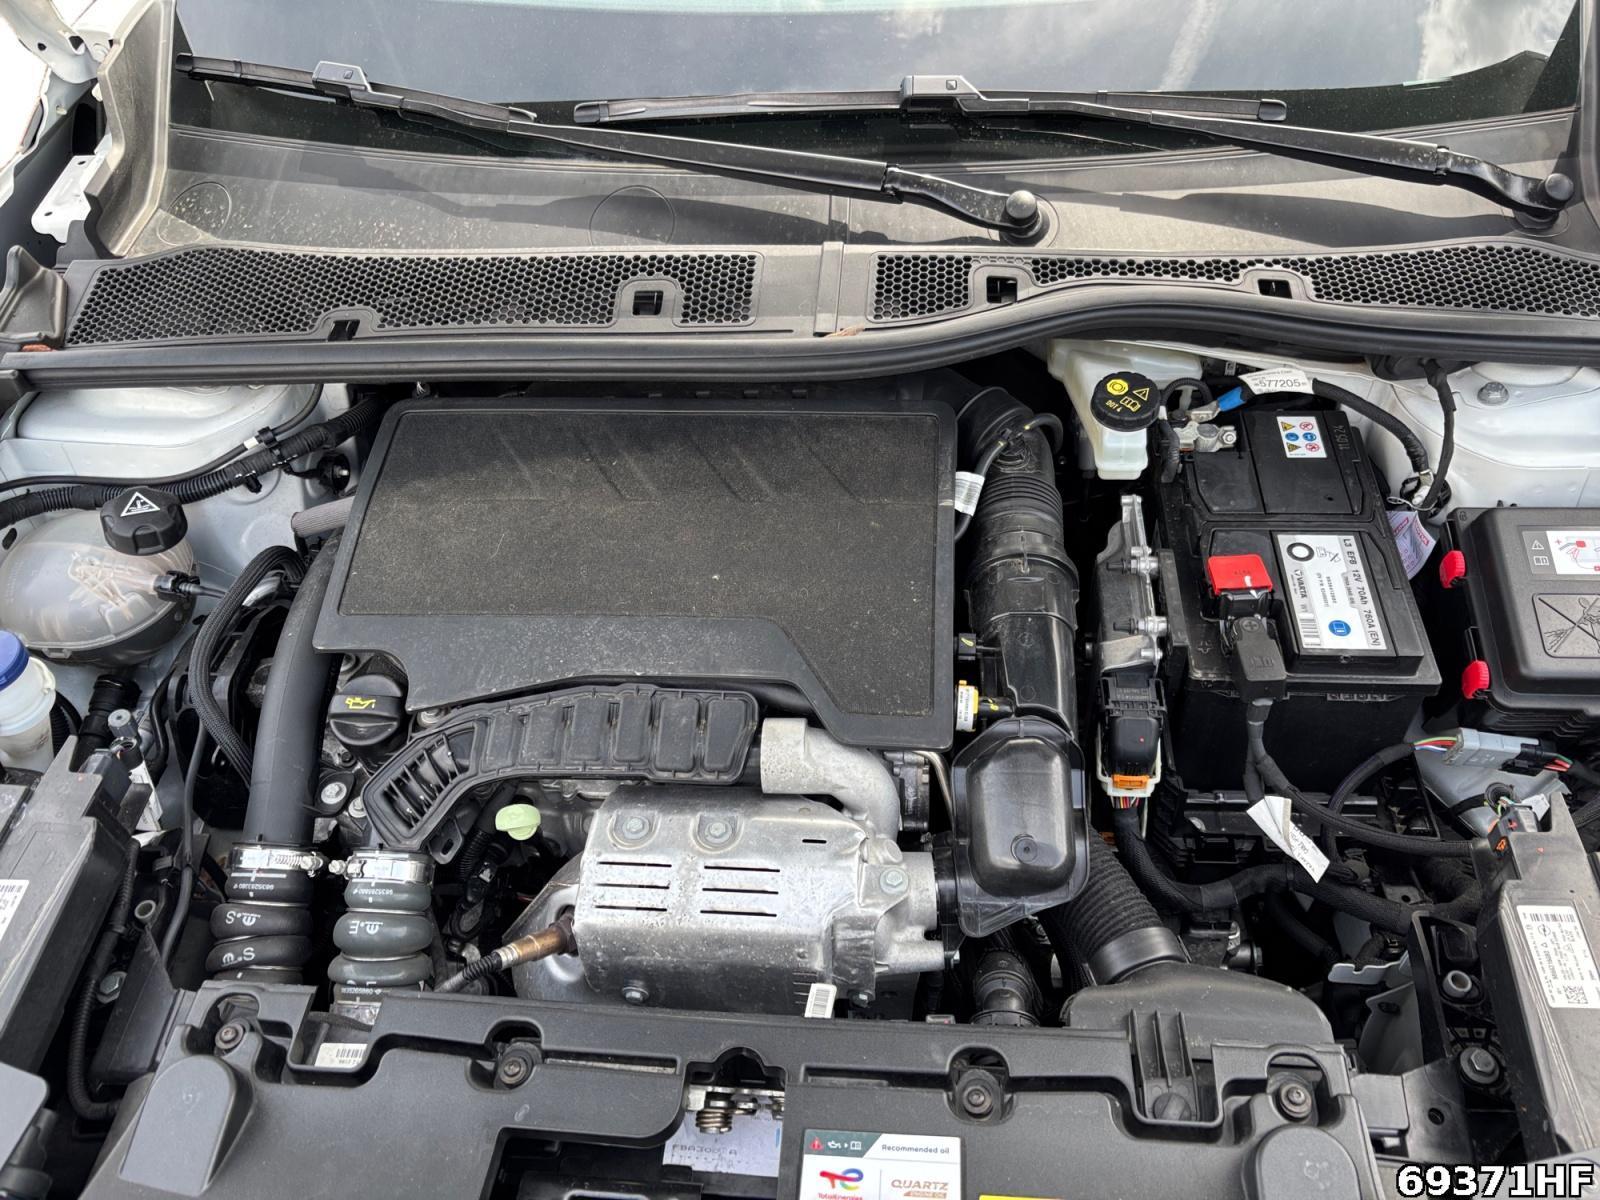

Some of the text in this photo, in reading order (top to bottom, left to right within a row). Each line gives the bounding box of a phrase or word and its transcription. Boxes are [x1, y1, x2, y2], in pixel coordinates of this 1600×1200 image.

[1105, 400, 1119, 410] DOT
[1343, 538, 1353, 549] L3
[1346, 550, 1358, 565] EFB
[1352, 569, 1363, 583] 12V
[1296, 577, 1308, 599] VARTA
[1356, 586, 1369, 606] 70Ah
[1363, 609, 1376, 630] 760A
[1367, 629, 1381, 647] (EN)
[881, 1144, 938, 1154] Recommended
[890, 1178, 949, 1191] QUARTZ
